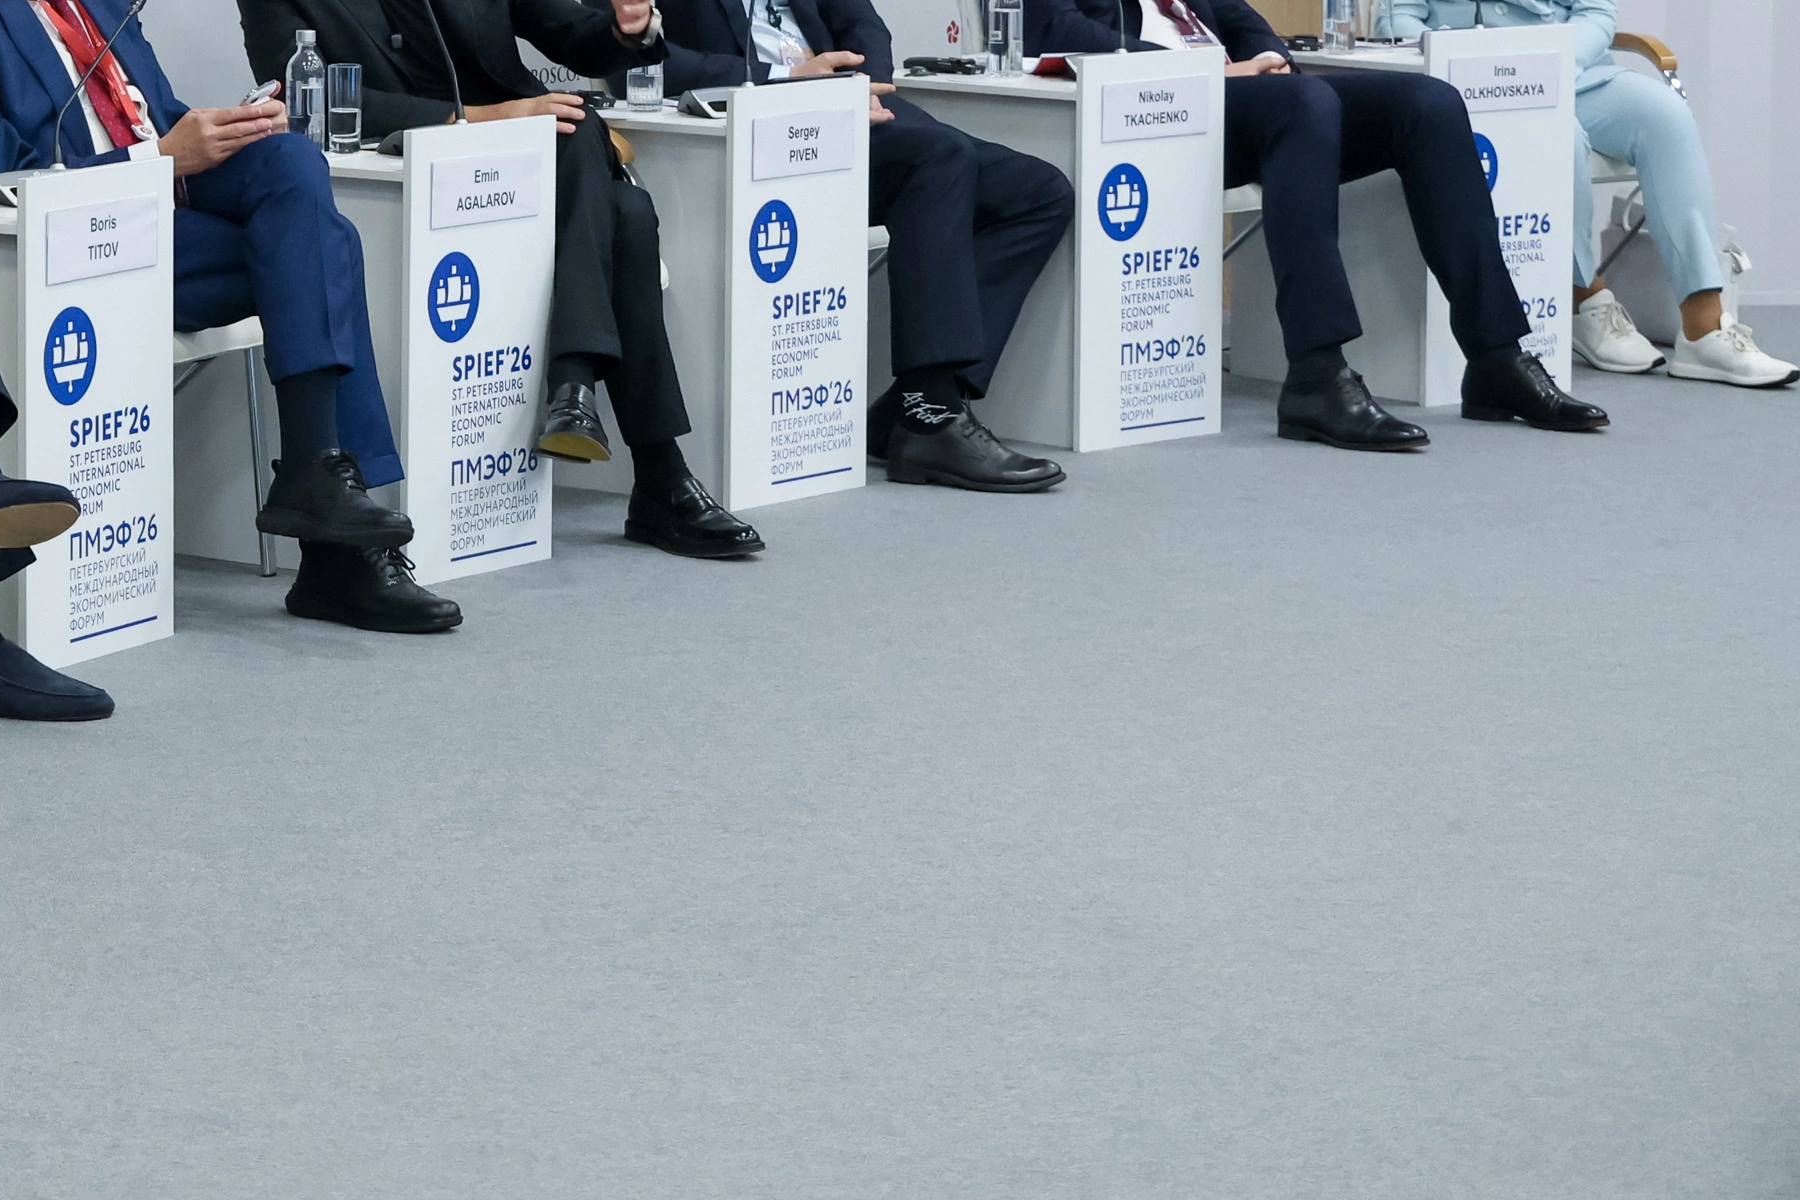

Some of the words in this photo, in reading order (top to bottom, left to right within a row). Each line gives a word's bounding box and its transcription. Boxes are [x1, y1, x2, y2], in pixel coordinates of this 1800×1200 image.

[1494, 65, 1516, 77] Irina
[1139, 90, 1174, 104] Nikolay
[1464, 84, 1544, 100] OLKHOVSKAYA
[1125, 110, 1188, 127] TKACHENKO
[788, 126, 819, 140] Sergey
[790, 148, 818, 162] PIVEN
[475, 169, 499, 183] Emin
[457, 191, 515, 211] AGALAROV
[90, 215, 117, 233] Boris
[88, 241, 119, 261] TITOV
[1122, 281, 1133, 291] ST.
[1136, 274, 1191, 289] PETERSBURG
[1121, 287, 1194, 304] INTERNATIONAL
[1121, 303, 1170, 319] ECONOMIC
[772, 325, 783, 336] ST.
[786, 316, 838, 334] PETERSBURG
[1121, 319, 1153, 332] FORUM
[772, 330, 841, 351] INTERNATIONAL
[772, 348, 819, 366] ECONOMIC
[772, 365, 802, 380] FORUM
[1120, 360, 1194, 382] ПЕТЕРБУРГСКИЙ
[452, 388, 464, 400] ST.
[467, 378, 523, 398] PETERSBURG
[1120, 372, 1206, 394] МЕЖДУНАРОДНЫЙ
[452, 393, 526, 416] INTERNATIONAL
[1120, 387, 1204, 409] ЭКОНОМИЧЕСКИЙ
[452, 412, 502, 432] ECONOMIC
[771, 408, 841, 433] ПЕТЕРБУРГСКИЙ
[1120, 409, 1153, 422] ФОРУМ
[452, 431, 484, 448] FORUM
[771, 420, 853, 447] МЕЖДУНАРОДНЫЙ
[70, 455, 83, 468] ST.
[84, 440, 142, 466] PETERSBURG
[771, 435, 851, 462] ЭКОНОМИЧЕСКИЙ
[69, 456, 145, 485] INTERNATIONAL
[771, 460, 803, 475] ФОРУМ
[451, 477, 526, 505] ПЕТЕРБУРГСКИЙ
[82, 499, 103, 516] RUM
[451, 490, 538, 520] МЕЖДУНАРОДНЫЙ
[451, 506, 536, 536] ЭКОНОМИЧЕСКИЙ
[451, 534, 484, 551] ФОРУМ
[70, 547, 146, 581] ПЕТЕРБУРГСКИЙ
[70, 560, 158, 598] МЕЖДУНАРОДНЫЙ
[70, 578, 156, 615] ЭКОНОМИЧЕСКИЙ
[70, 611, 104, 632] ФОРУМ
